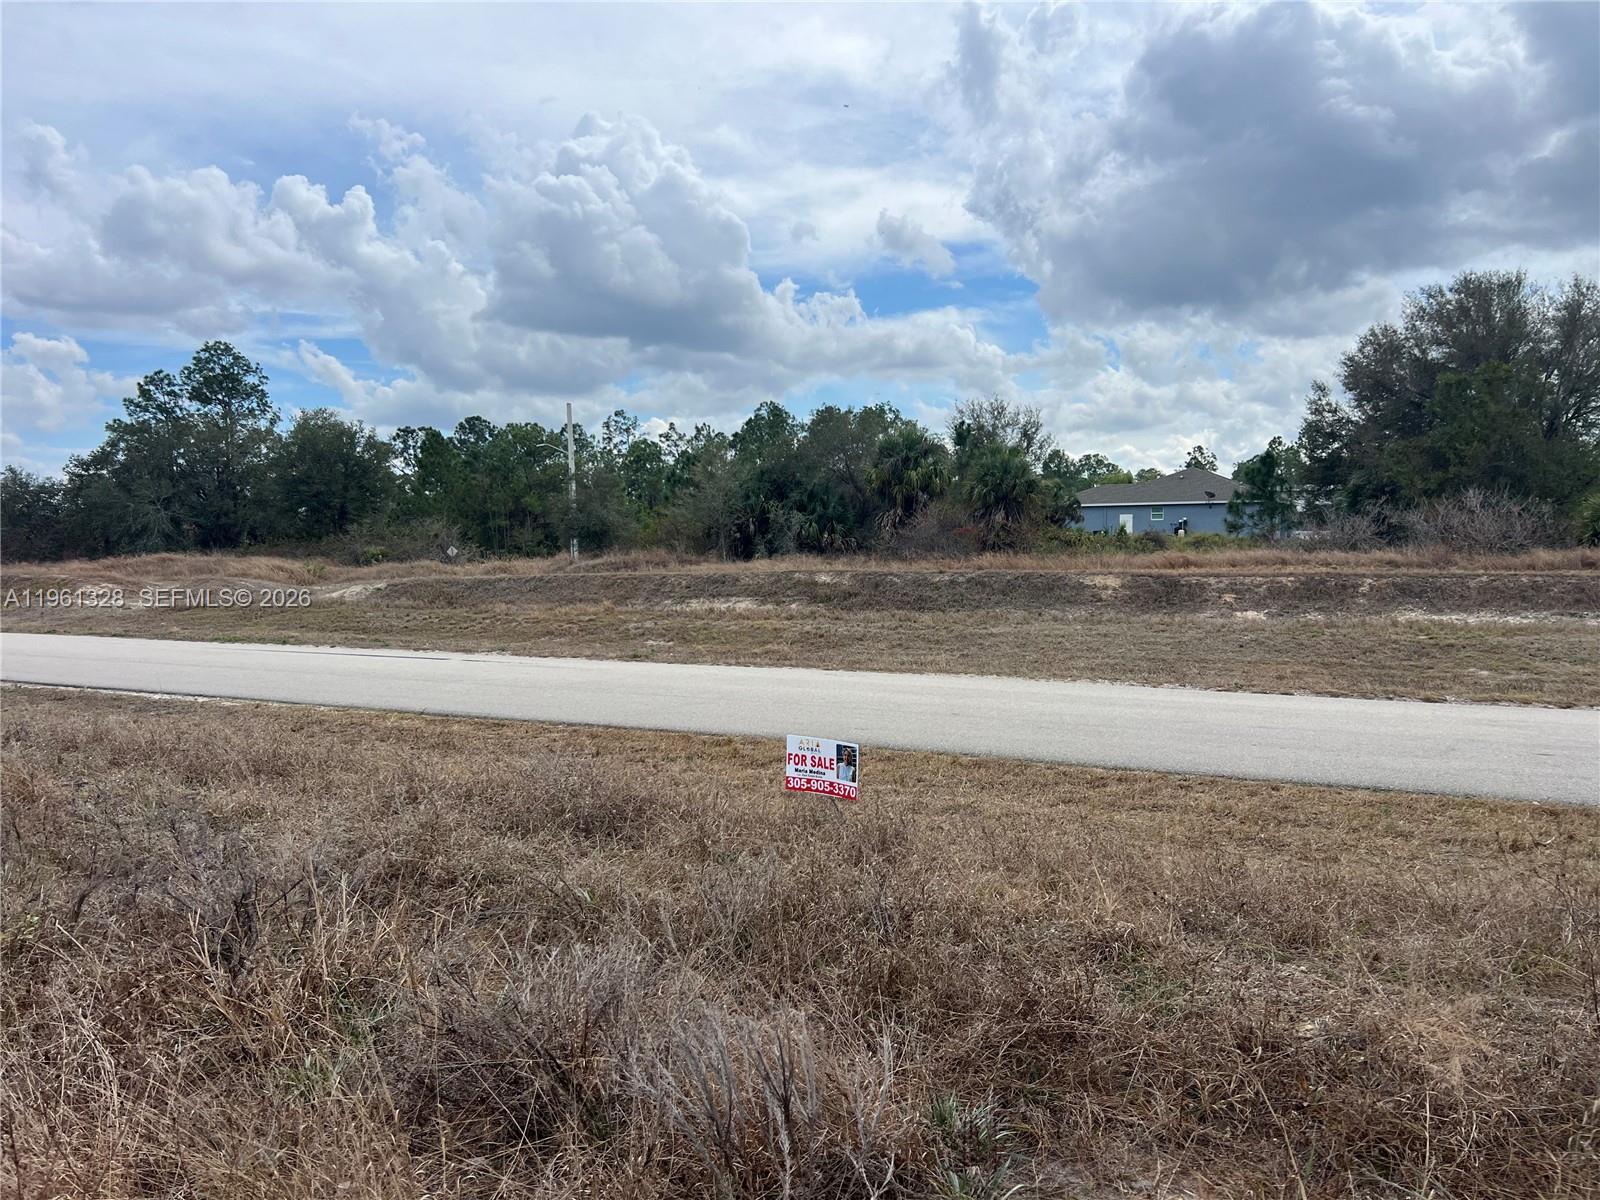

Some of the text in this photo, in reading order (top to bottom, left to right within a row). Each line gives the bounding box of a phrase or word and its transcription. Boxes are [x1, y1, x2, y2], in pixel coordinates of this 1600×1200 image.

[787, 753, 835, 771] FOR SALE
[787, 777, 856, 798] 305-905-3370
